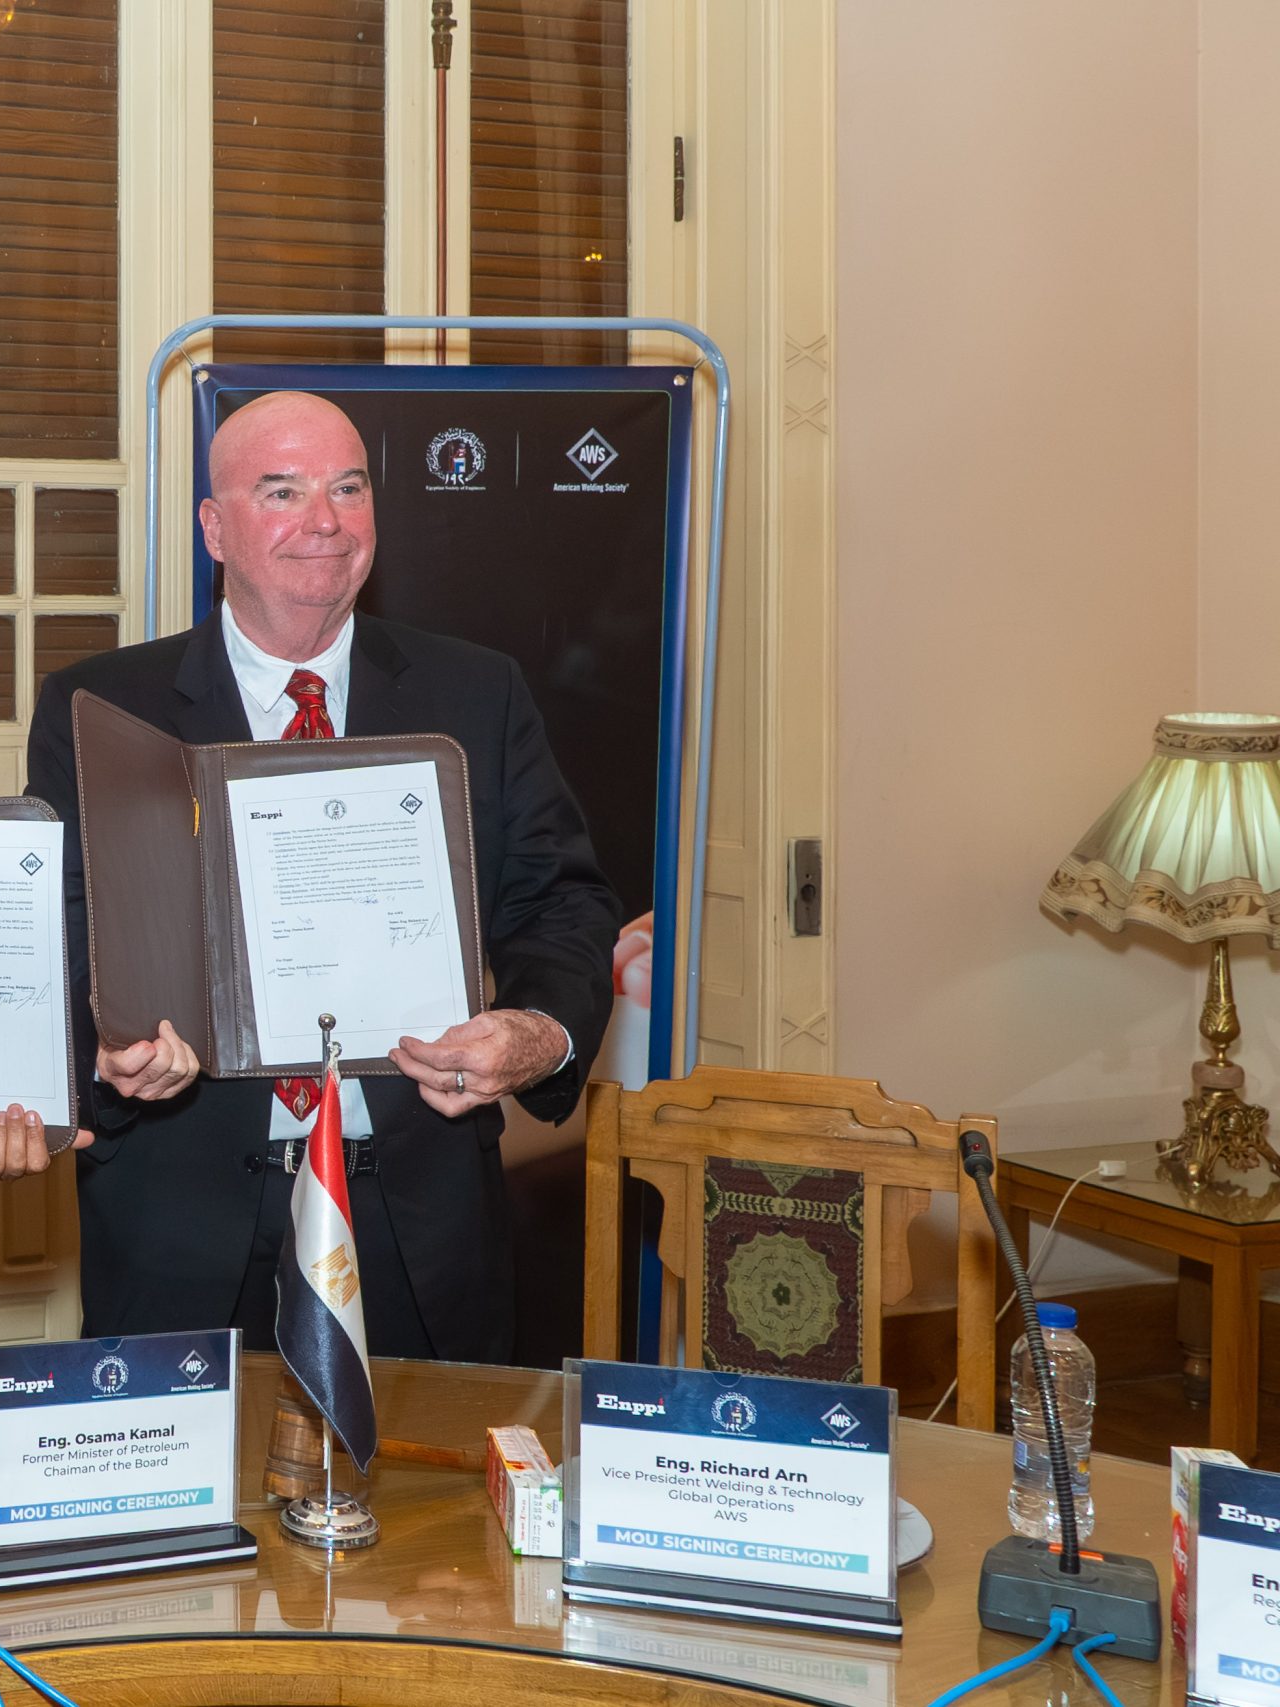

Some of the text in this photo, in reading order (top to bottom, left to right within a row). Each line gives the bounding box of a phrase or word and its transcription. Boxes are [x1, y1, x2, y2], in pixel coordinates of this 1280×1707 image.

[579, 445, 606, 464] AWS
[553, 483, 581, 492] American
[581, 483, 604, 493] Welding
[250, 808, 283, 820] Enppi
[185, 1360, 202, 1373] AWS
[597, 1393, 666, 1417] Enppi
[830, 1413, 851, 1428] AWS
[38, 1425, 175, 1449] Eng. Osama Kamal
[22, 1440, 190, 1464] Former Minister of Petroleum
[43, 1456, 168, 1477] Chaiman of the Board
[655, 1456, 808, 1484] Eng. Richard Arn
[602, 1466, 864, 1508] Vice President Welding & Technology
[10, 1490, 199, 1521] MOU SIGNING CEREMONY
[668, 1489, 795, 1513] Global Operations
[714, 1510, 748, 1523] AWS
[615, 1529, 849, 1569] MOU SIGNING CEREMONY
